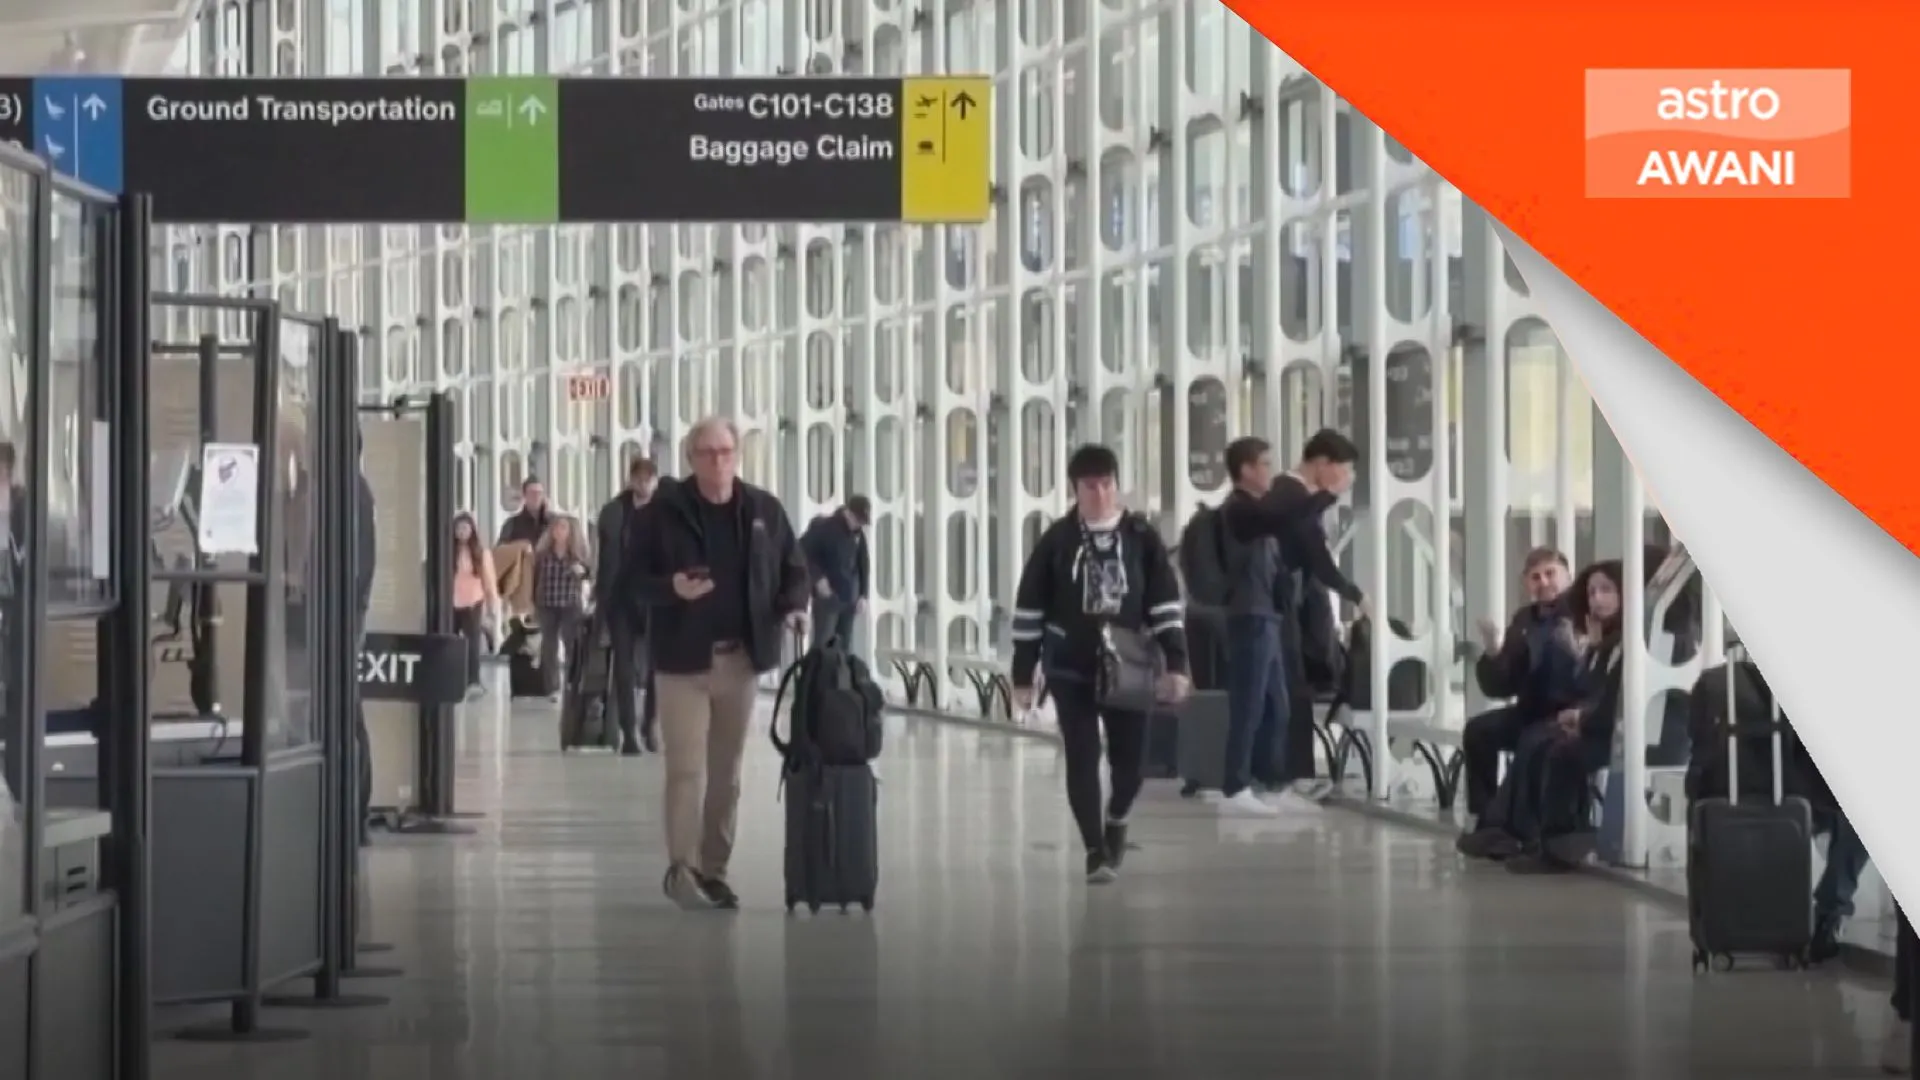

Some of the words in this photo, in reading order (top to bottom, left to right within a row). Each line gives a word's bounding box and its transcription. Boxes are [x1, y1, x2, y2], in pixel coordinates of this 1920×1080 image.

[147, 96, 249, 121] Ground
[257, 96, 456, 126] Transportation
[694, 94, 744, 111] Gates
[749, 93, 893, 118] C101-C138
[690, 135, 809, 165] Baggage
[816, 135, 893, 159] Claim
